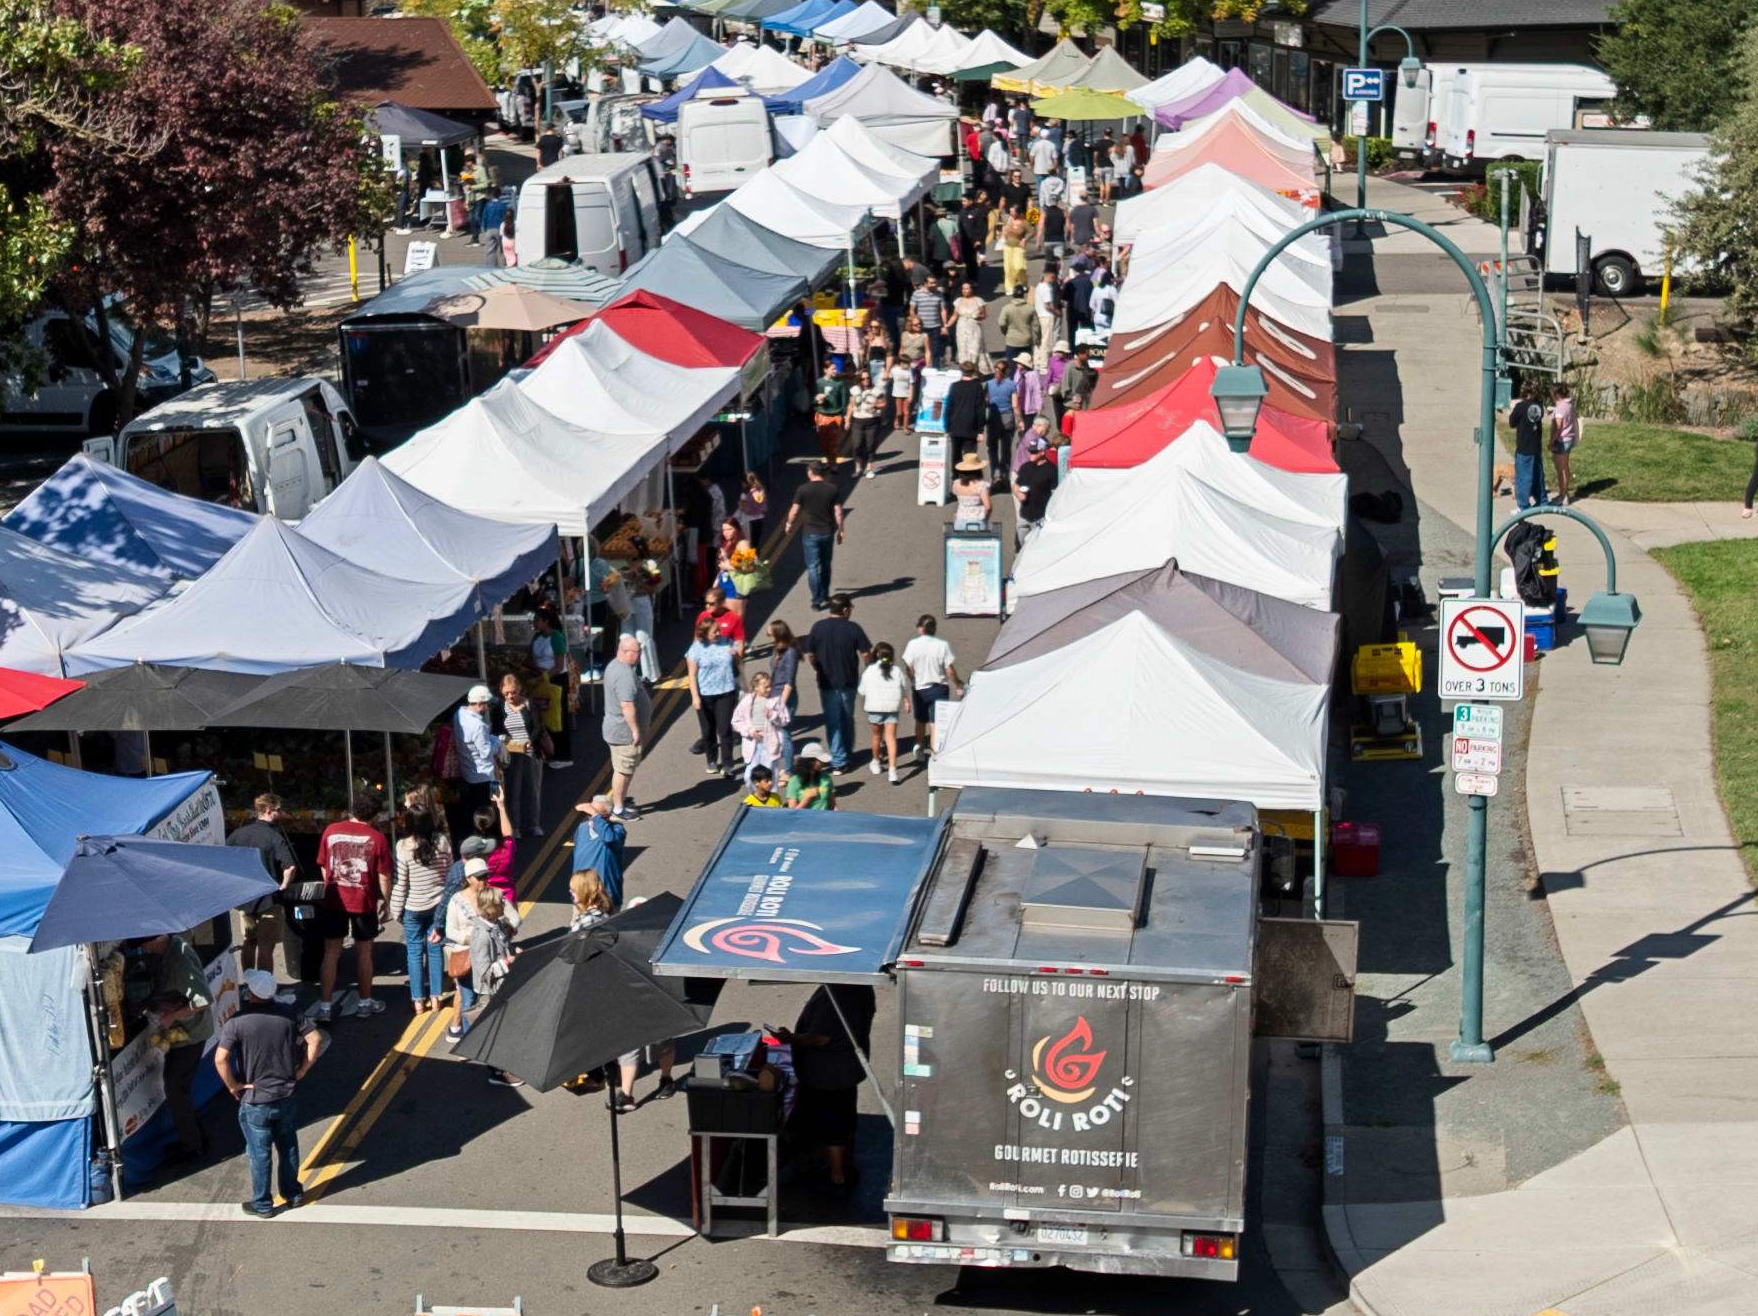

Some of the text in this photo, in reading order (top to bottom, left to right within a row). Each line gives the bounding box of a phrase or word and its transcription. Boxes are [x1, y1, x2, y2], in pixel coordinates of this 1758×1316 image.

[1445, 678, 1516, 693] OVER 3 TONS
[766, 876, 793, 895] ROLI
[755, 897, 783, 916] ROTI
[983, 978, 1160, 1000] FOLLOW US TO OUR NEXT STOP
[1006, 1083, 1131, 1131] ROLI ROTI
